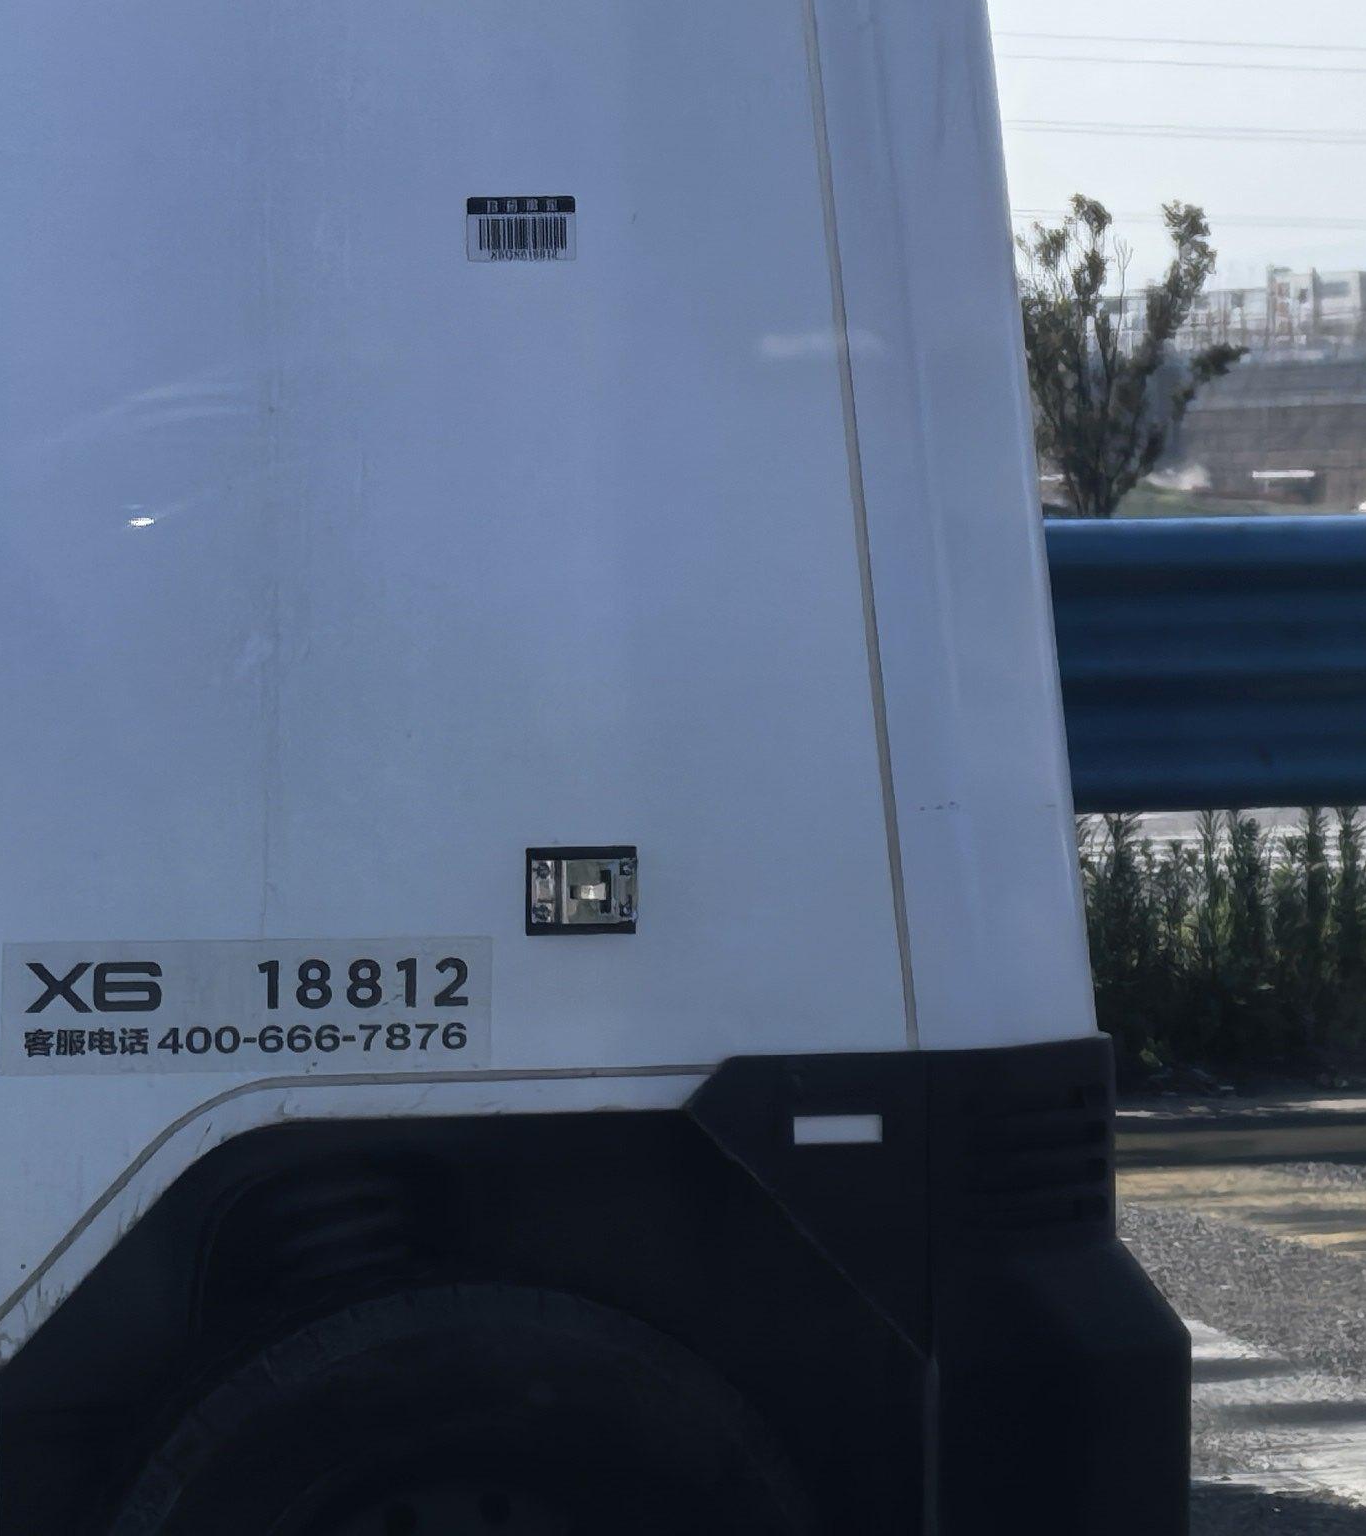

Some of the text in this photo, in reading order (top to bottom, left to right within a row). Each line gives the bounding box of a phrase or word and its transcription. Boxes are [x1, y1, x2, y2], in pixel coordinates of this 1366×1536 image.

[24, 957, 470, 1013] X6 18812
[23, 1022, 468, 1058] 客服电话 400-666-7876
